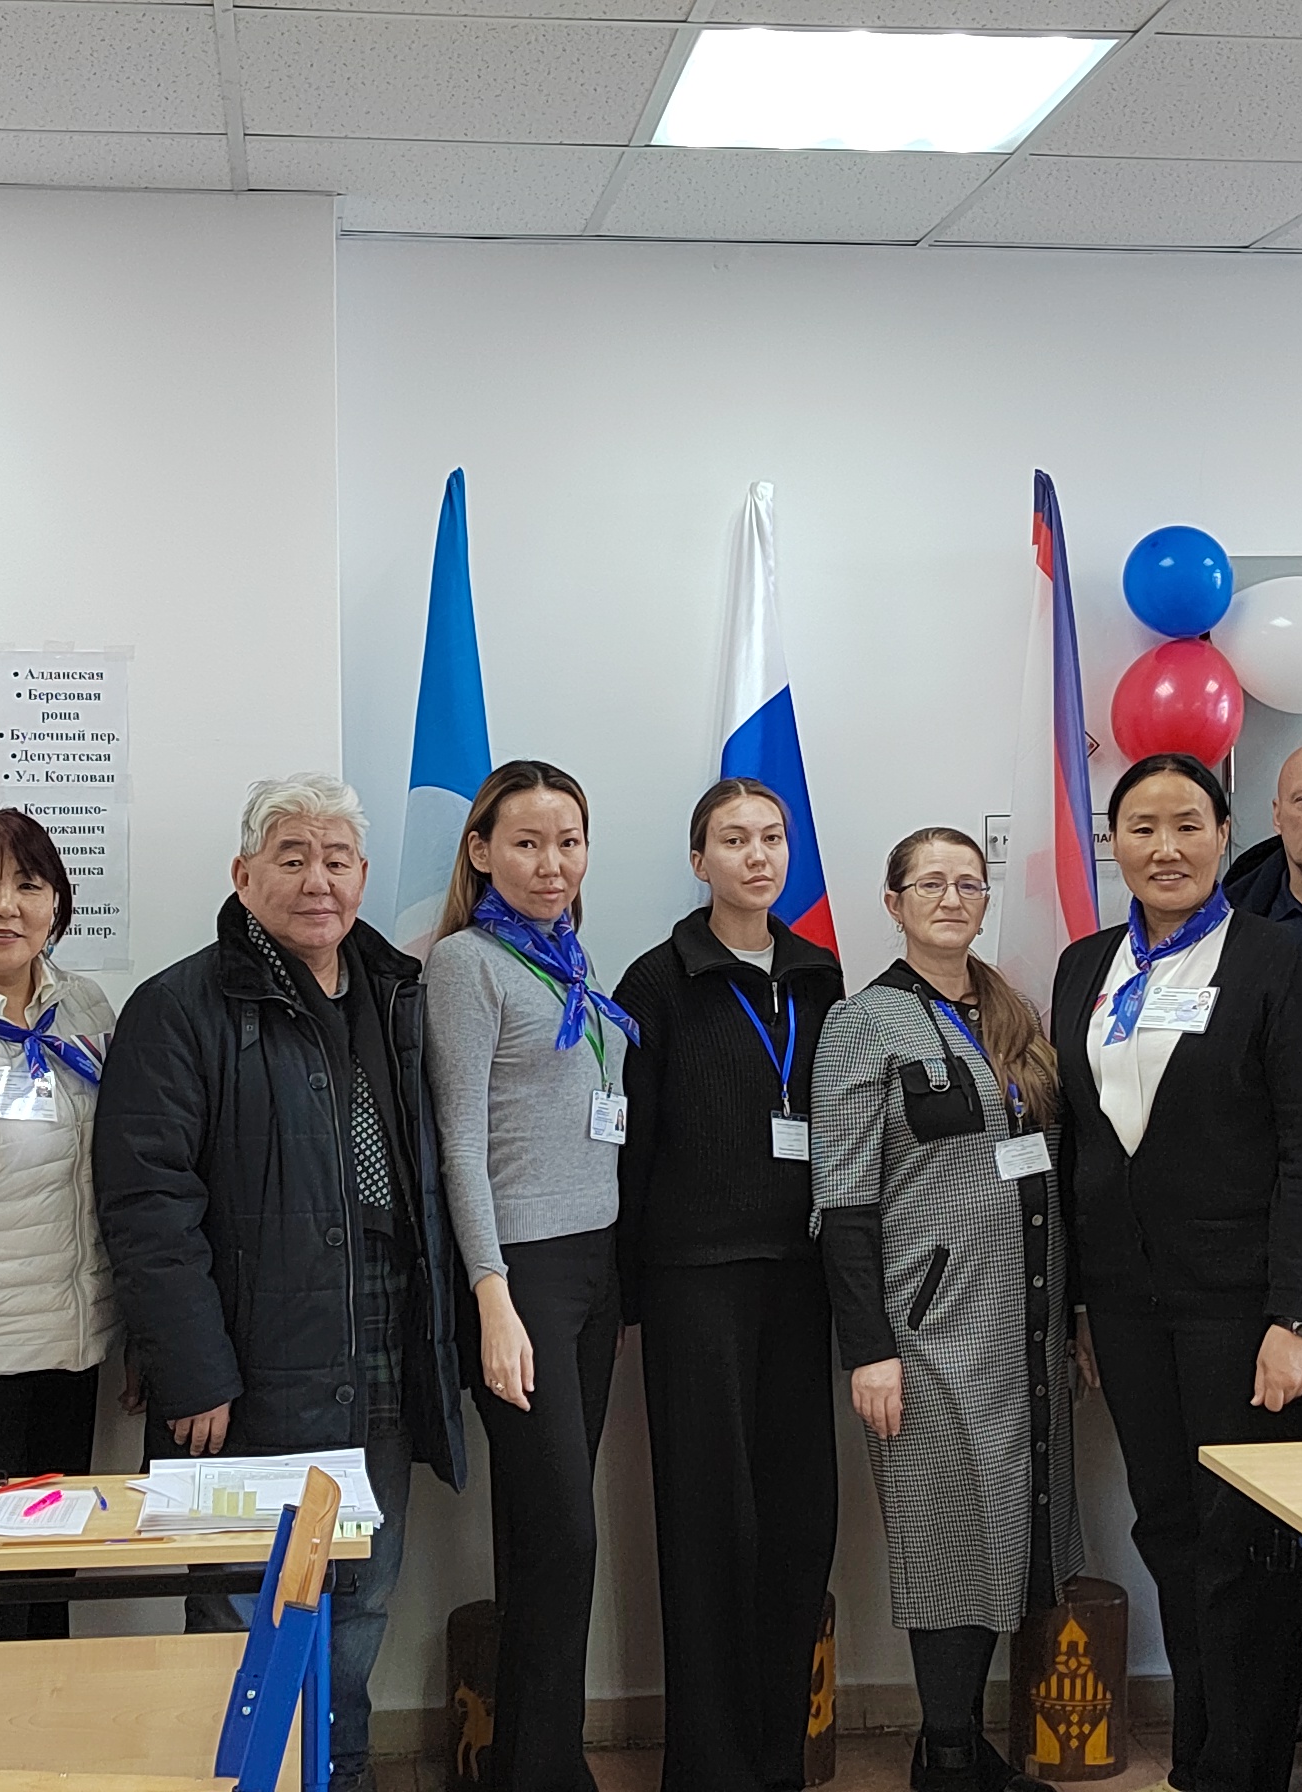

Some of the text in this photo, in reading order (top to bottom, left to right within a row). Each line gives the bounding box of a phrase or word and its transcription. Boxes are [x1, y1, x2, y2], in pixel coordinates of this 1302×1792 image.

[24, 668, 104, 681] Алданская
[28, 688, 102, 704] Березовая
[41, 711, 80, 723] роща
[10, 729, 120, 744] Булочный пер.
[17, 749, 111, 764] Депутатская
[15, 770, 115, 783] Ул. Котлован
[23, 803, 107, 816] Костюшко-
[46, 825, 105, 835] южанич
[87, 926, 117, 939] пер.
